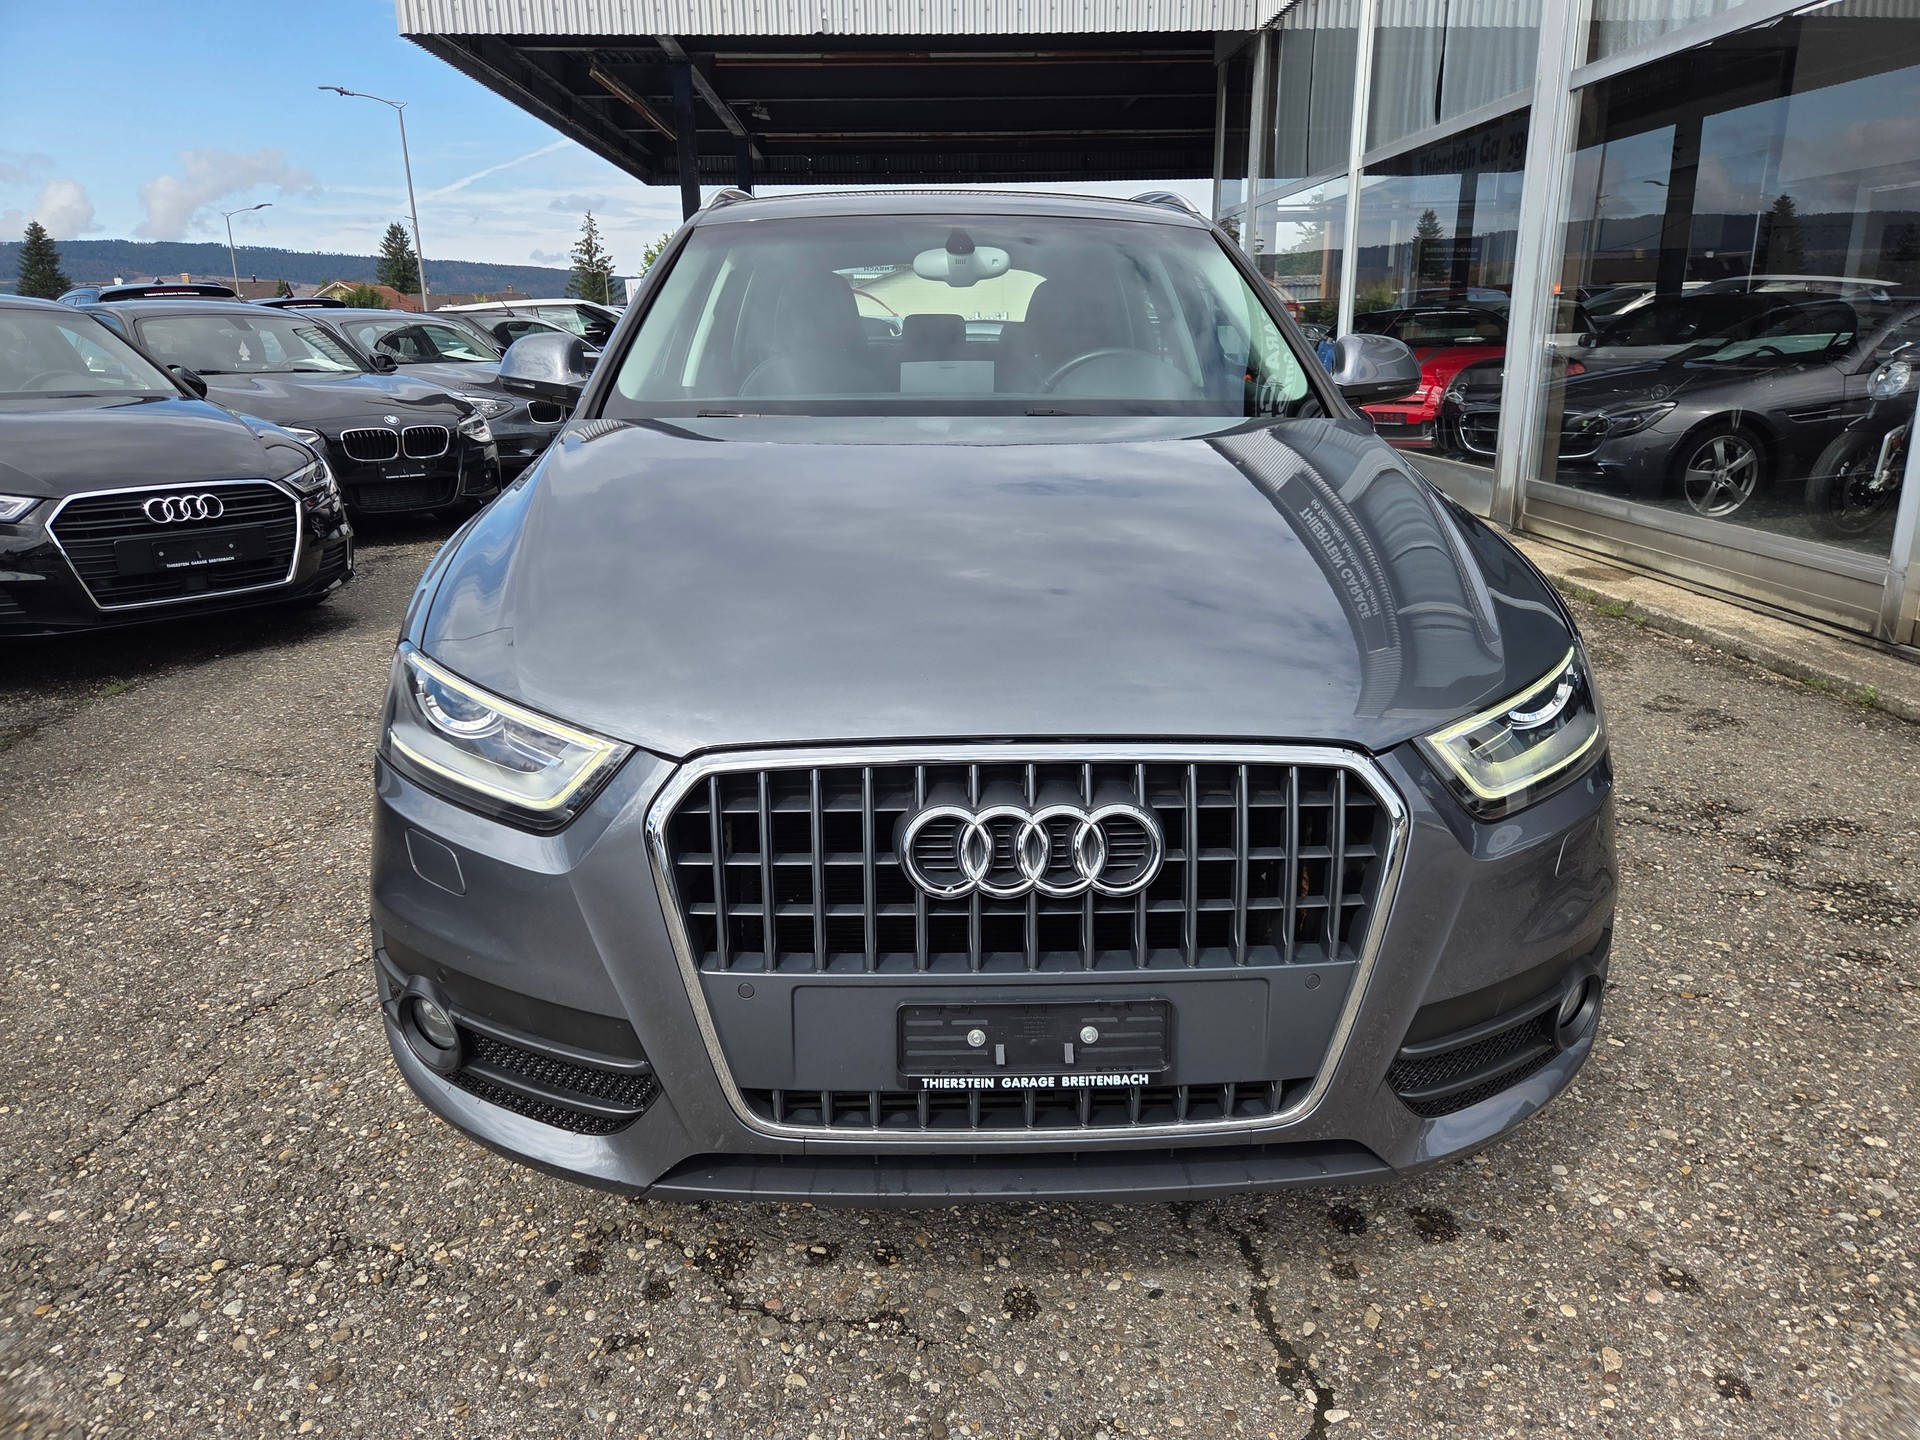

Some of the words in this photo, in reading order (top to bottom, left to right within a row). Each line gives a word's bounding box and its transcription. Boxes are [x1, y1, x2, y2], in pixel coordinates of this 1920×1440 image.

[921, 1077, 995, 1089] THIERSTEIN
[1001, 1076, 1055, 1089] GARAGE
[1061, 1073, 1149, 1087] BREITENBACH
